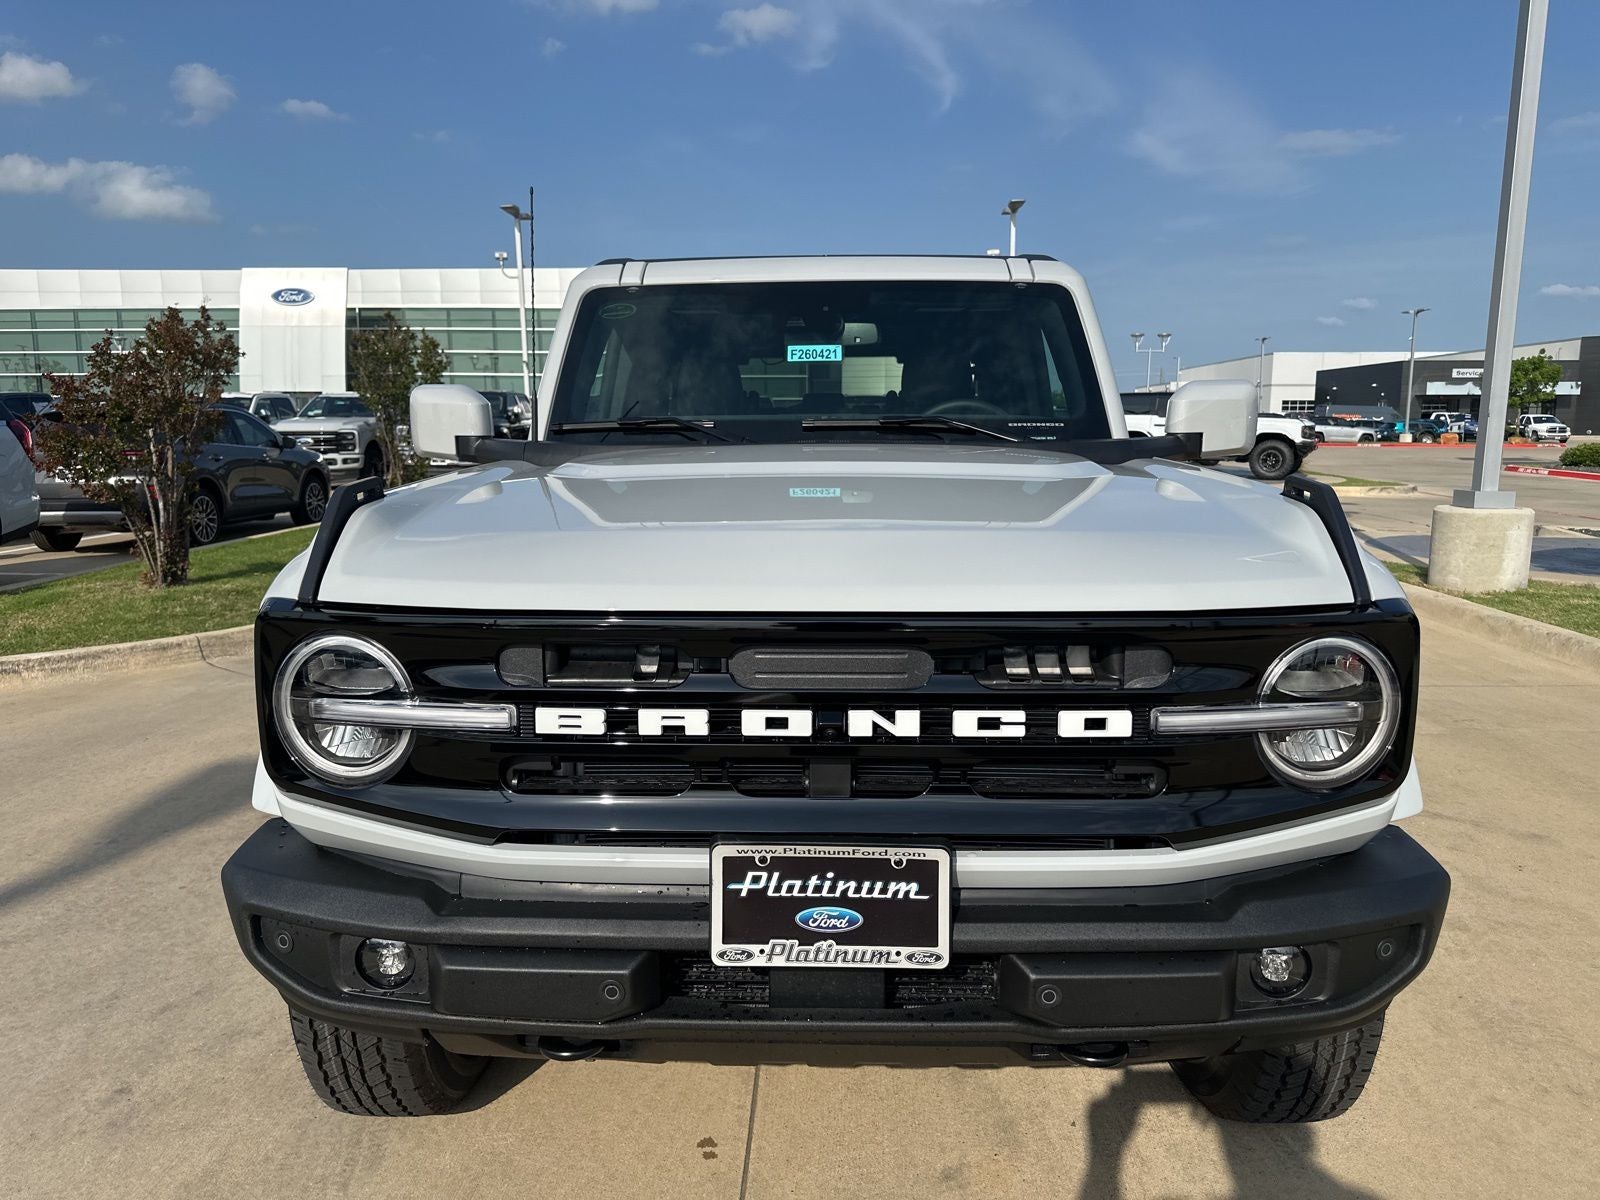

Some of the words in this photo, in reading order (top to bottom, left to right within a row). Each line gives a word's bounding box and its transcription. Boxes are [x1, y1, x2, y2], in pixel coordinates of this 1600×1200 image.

[278, 290, 305, 302] Ford
[790, 348, 838, 360] F260421
[535, 706, 1133, 738] BRONCO
[736, 847, 927, 858] www.PlatinumFord.com
[726, 871, 930, 899] Platinum
[808, 910, 849, 928] Ford
[723, 950, 748, 961] Ford
[757, 939, 902, 965] Platinum
[911, 953, 937, 963] Ford
